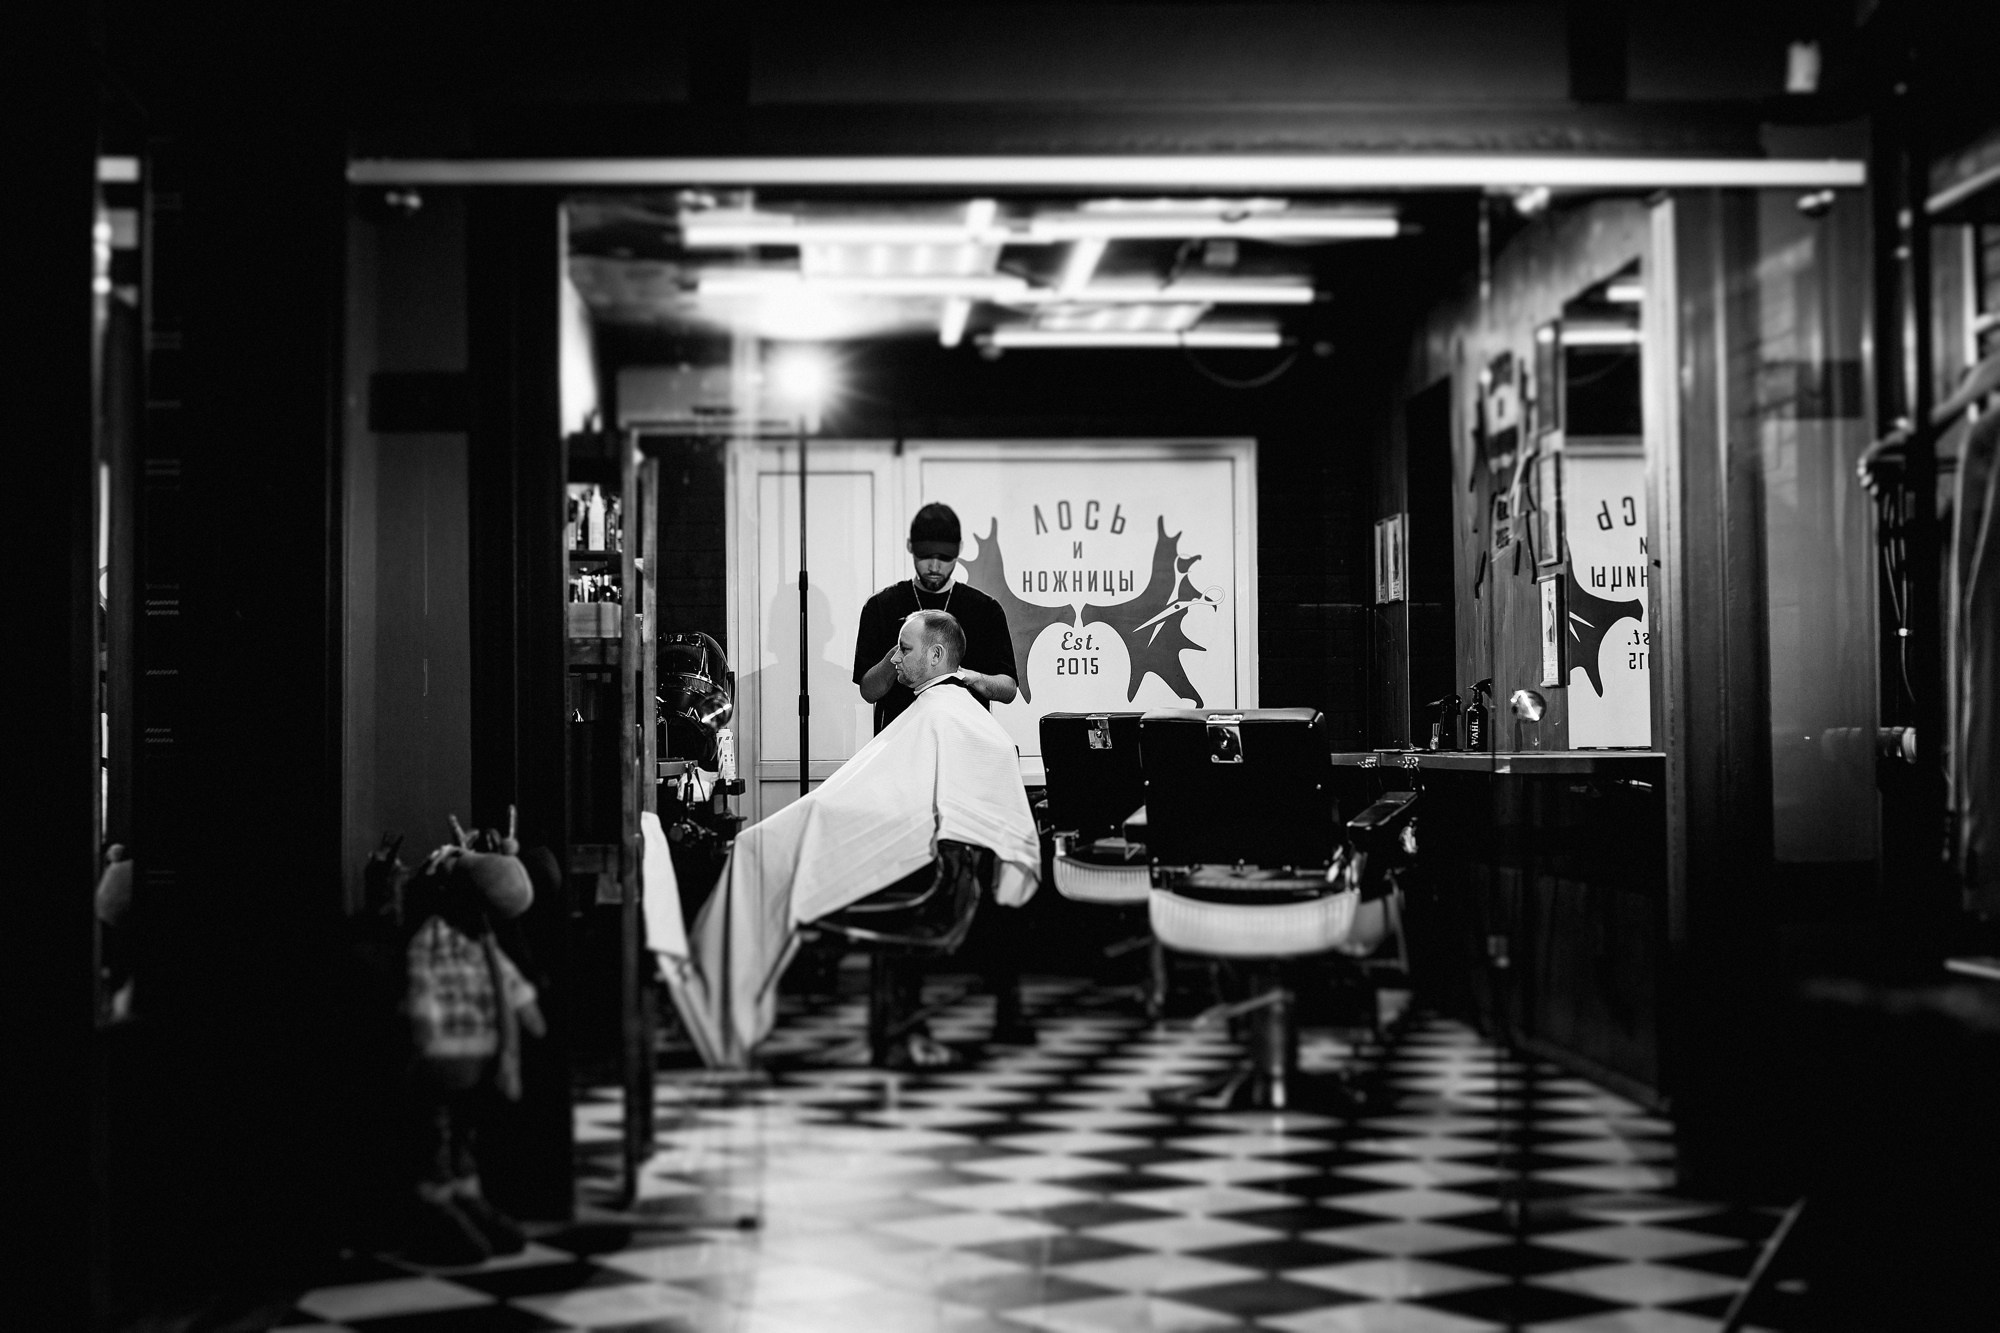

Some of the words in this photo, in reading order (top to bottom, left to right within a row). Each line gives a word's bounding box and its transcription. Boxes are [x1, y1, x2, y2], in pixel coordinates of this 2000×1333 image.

[1033, 500, 1126, 535] ЛОСЬ
[1073, 541, 1082, 559] И
[1022, 570, 1134, 597] НОЖНИЦЫ
[1060, 631, 1100, 651] Est.
[1056, 658, 1099, 675] 2015
[1470, 719, 1479, 745] WAHL
